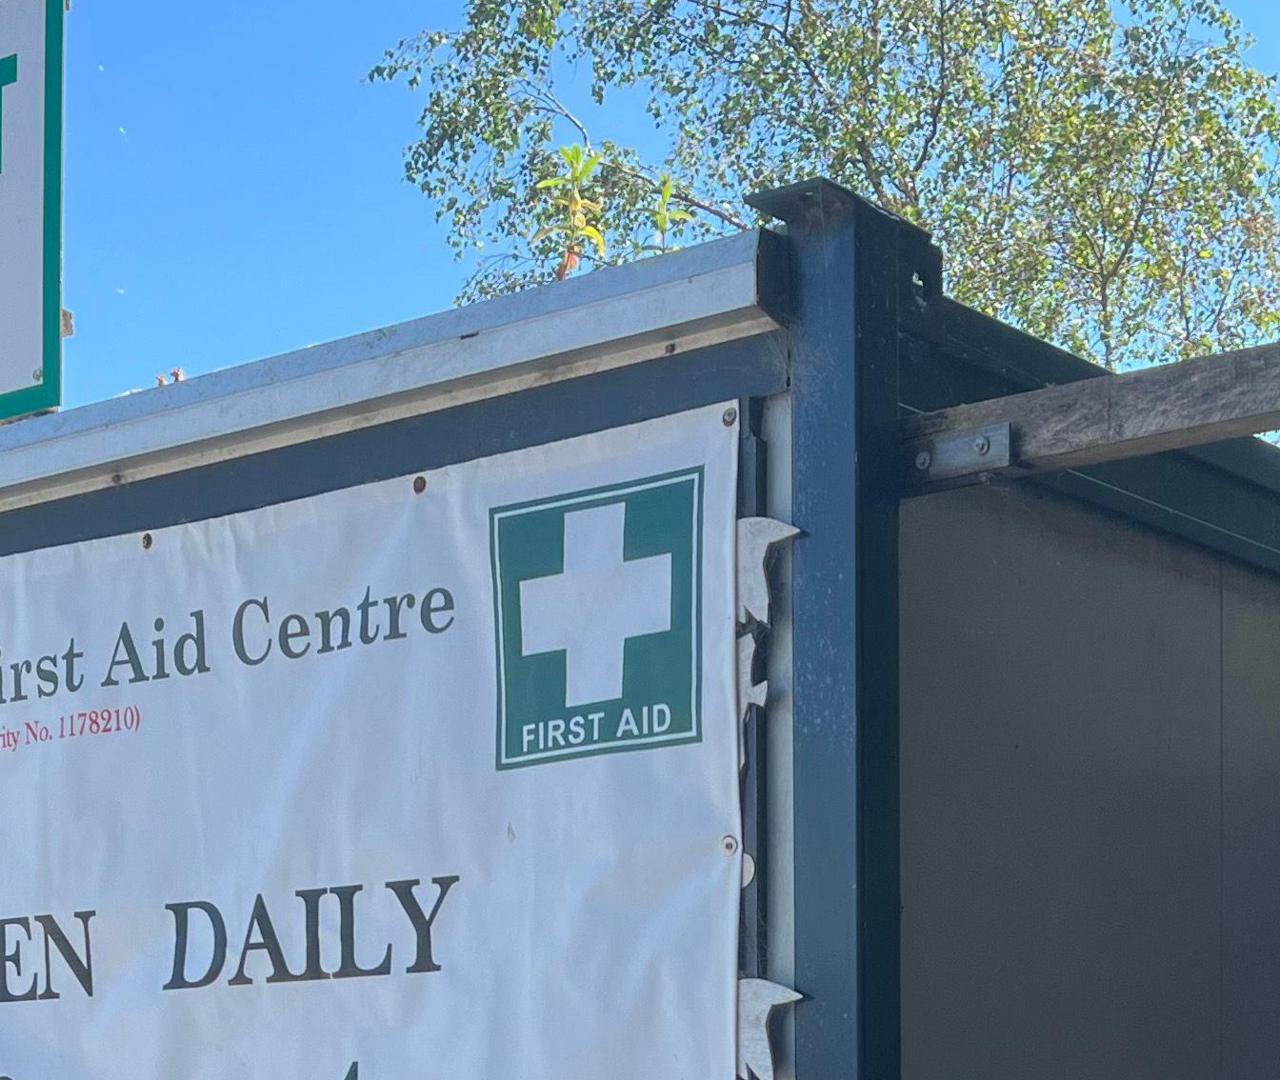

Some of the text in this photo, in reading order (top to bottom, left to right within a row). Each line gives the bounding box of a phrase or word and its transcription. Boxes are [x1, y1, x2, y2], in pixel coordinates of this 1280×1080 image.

[100, 608, 210, 689] Aid
[231, 586, 457, 667] Centre
[24, 722, 53, 748] No.
[57, 705, 142, 742] 1178210)
[519, 702, 673, 754] FIRST AID
[162, 874, 460, 992] DAILY
